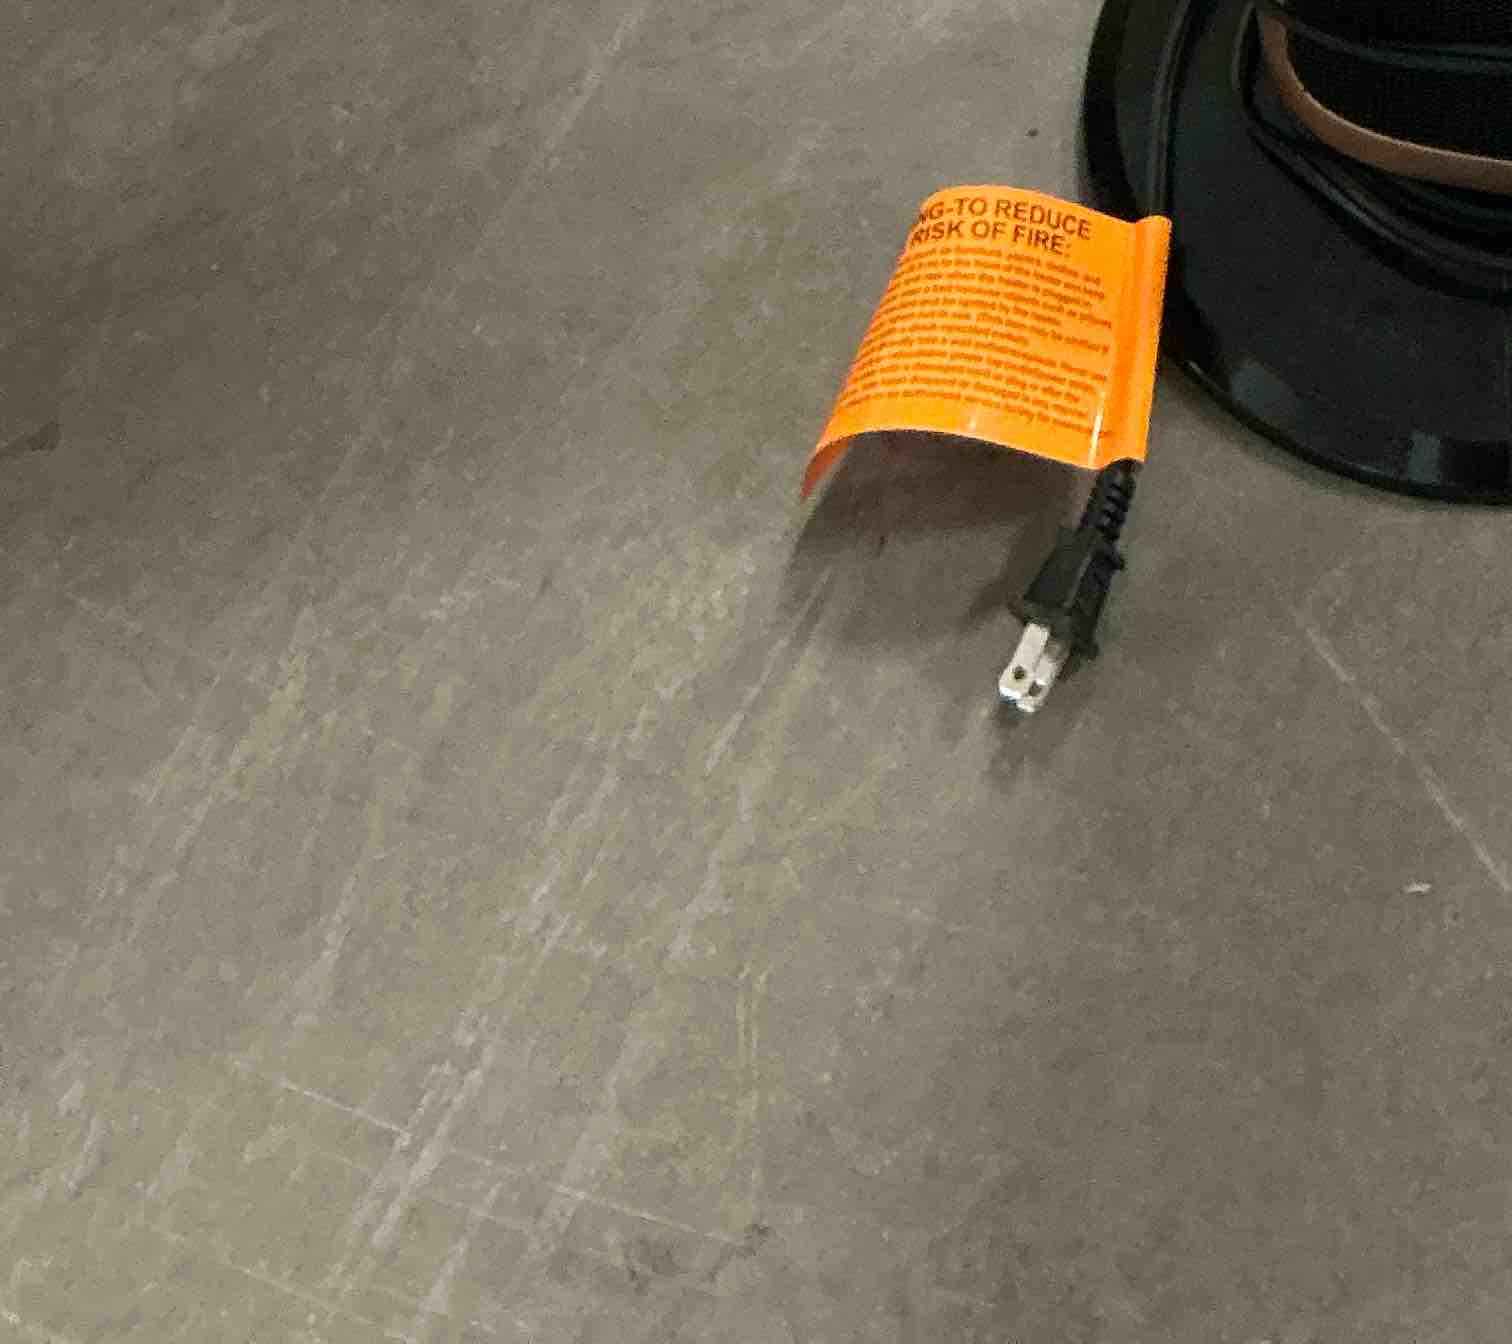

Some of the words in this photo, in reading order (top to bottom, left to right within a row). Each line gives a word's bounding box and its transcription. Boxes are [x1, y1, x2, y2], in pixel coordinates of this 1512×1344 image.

[910, 220, 963, 248] RISK
[970, 219, 1007, 240] OF
[1012, 224, 1071, 258] FIRE:
[995, 199, 1092, 241] REDUCE
